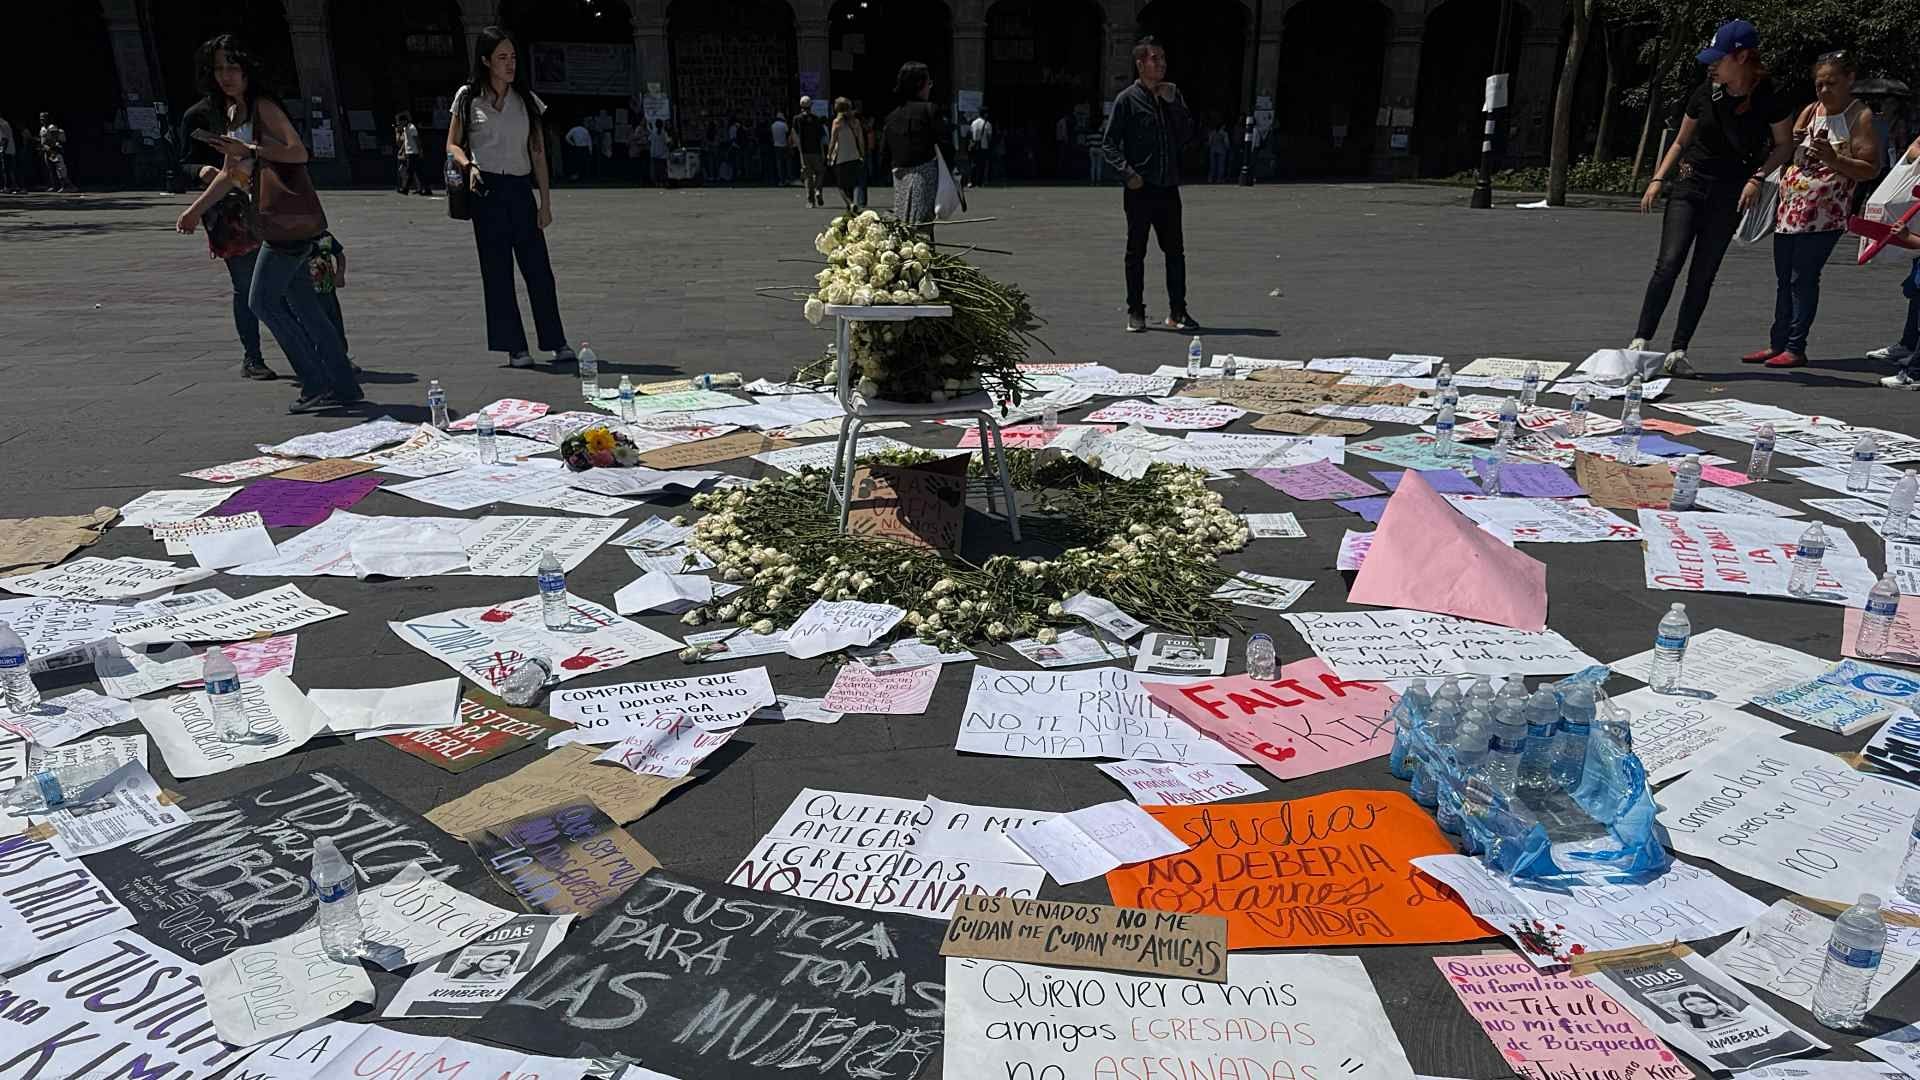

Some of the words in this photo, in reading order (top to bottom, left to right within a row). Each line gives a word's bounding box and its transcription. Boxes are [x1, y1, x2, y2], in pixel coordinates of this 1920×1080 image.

[1294, 613, 1359, 631] Para
[1364, 612, 1401, 630] la
[1399, 628, 1429, 642] 10
[1331, 653, 1444, 670] Kimberly
[1383, 666, 1453, 678] vida
[697, 674, 738, 687] QUE
[1098, 670, 1130, 692] TU
[580, 704, 604, 715] EL
[618, 694, 678, 710] DOLOR
[1179, 673, 1379, 720] FALTA
[574, 718, 610, 731] NO
[966, 711, 1022, 731] NO
[1036, 714, 1064, 733] TE
[1077, 715, 1177, 741] NUBLE
[620, 747, 664, 774] Kim
[1781, 764, 1865, 808] LIBRE
[804, 793, 933, 828] QUIERO
[947, 812, 969, 831] A
[790, 820, 922, 848] AMIGAS
[762, 842, 970, 882] EGRESADAS
[1147, 858, 1203, 887] NO
[1215, 844, 1397, 883] DEBERIA
[624, 878, 900, 961] JUSTICIA
[963, 895, 1002, 917] LOS
[1011, 898, 1101, 926] VENADOS
[1115, 909, 1148, 931] NO
[1154, 913, 1191, 933] ME
[1248, 905, 1394, 939] VIDA
[1582, 897, 1719, 950] KIMBERLY
[590, 913, 735, 978] PARA
[948, 915, 1016, 944] CUIDAN
[1018, 924, 1044, 941] ME
[1044, 924, 1110, 956] CUIDAN
[1111, 932, 1144, 954] MIS
[1137, 937, 1223, 976] AMIGAS
[776, 949, 947, 1019] TODAS
[1447, 960, 1532, 980] Quiero
[1623, 967, 1687, 990] TODAS
[510, 953, 673, 1030] LAS
[1114, 979, 1168, 1008] ver
[1180, 982, 1207, 1007] a
[1216, 979, 1299, 1010] mis
[1457, 980, 1484, 996] mi
[1483, 976, 1568, 995] familia
[984, 1015, 1119, 1054] amigas
[1131, 1015, 1319, 1048] EGRESADAS
[1485, 1017, 1516, 1034] NO
[1523, 1017, 1556, 1033] mi
[1556, 1016, 1634, 1036] ficha
[1705, 1025, 1772, 1051] KIMBERLY
[270, 1033, 332, 1064] LA
[1506, 1035, 1532, 1053] de
[1092, 1055, 1321, 1080] ASESINADAS
